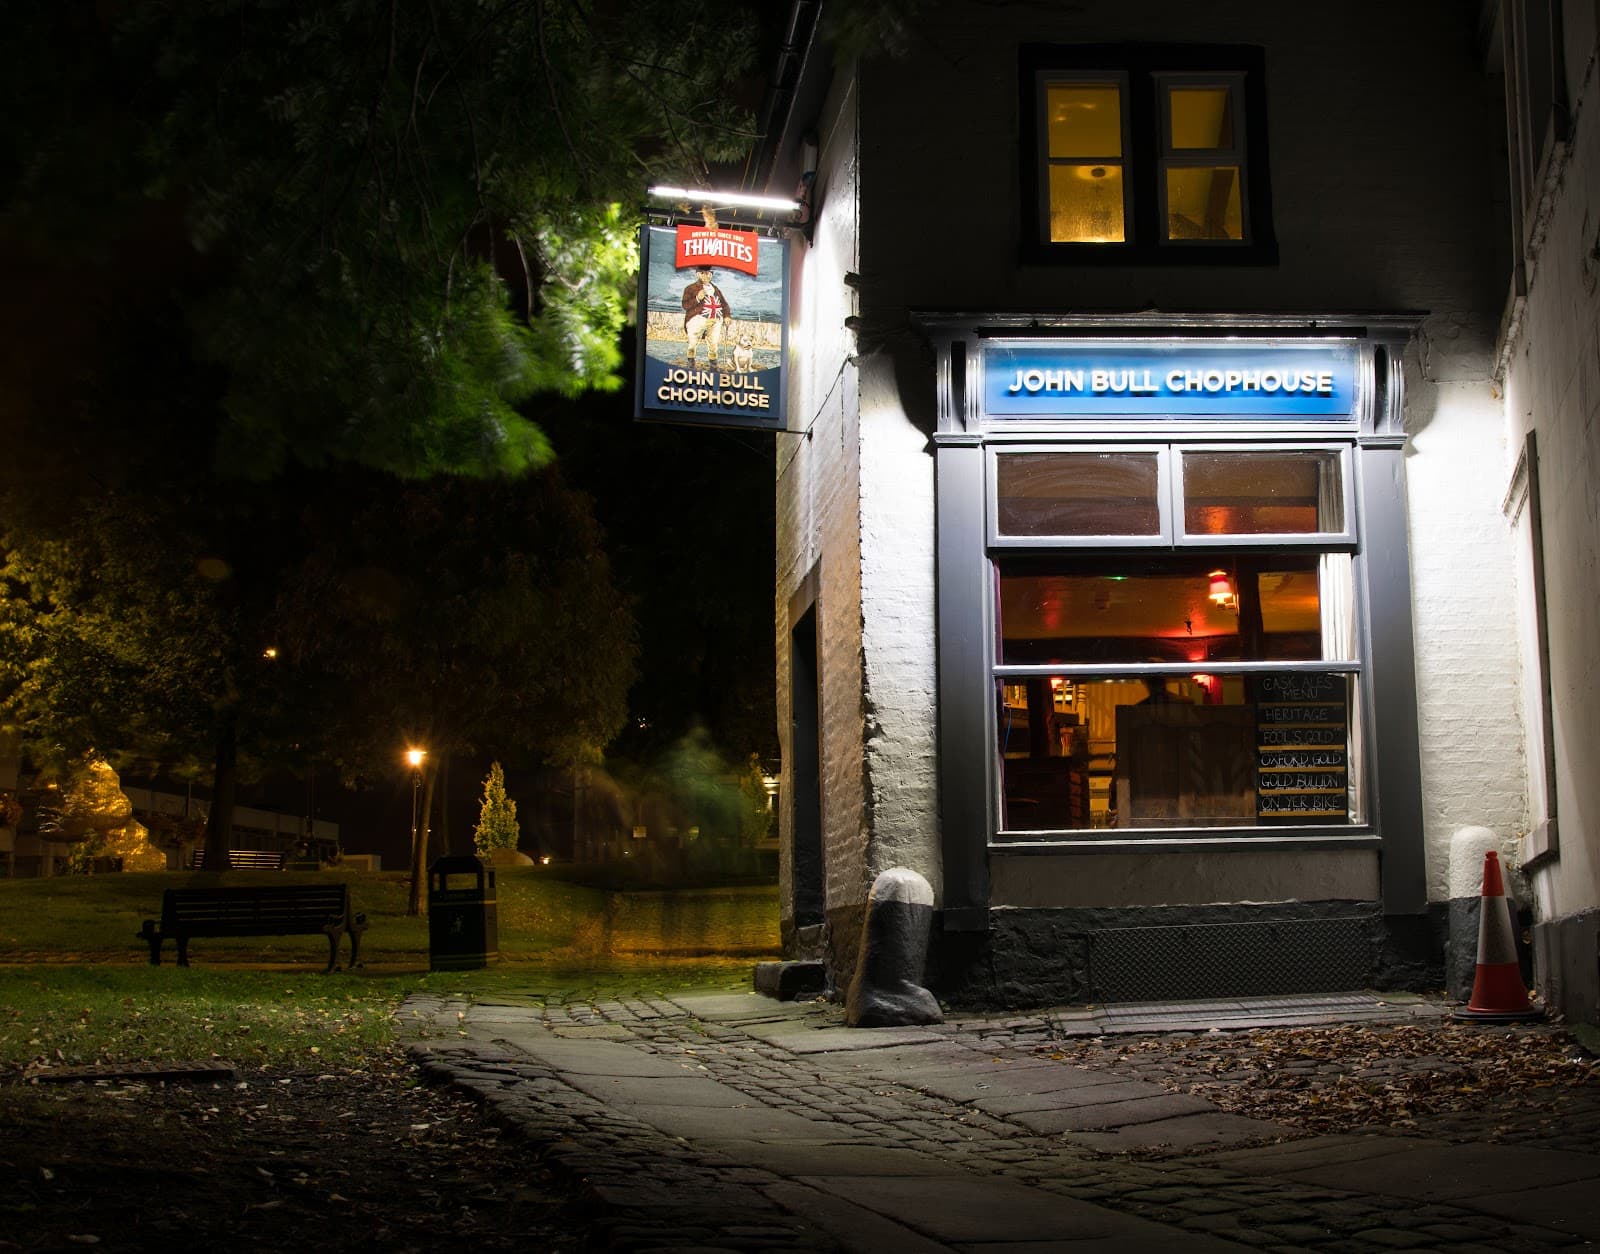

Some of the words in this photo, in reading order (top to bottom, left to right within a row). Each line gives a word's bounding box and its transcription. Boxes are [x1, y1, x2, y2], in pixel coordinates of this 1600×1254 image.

[683, 238, 753, 263] THWAITES
[663, 369, 714, 387] JOHN
[719, 373, 764, 391] BULL
[1008, 370, 1084, 392] JOHN
[1091, 370, 1159, 392] BULL
[1165, 370, 1334, 392] CHOPHOUSE
[657, 386, 770, 408] CHOPHOUSE
[1263, 676, 1295, 691] CASK
[1282, 687, 1318, 700] MENU
[1265, 708, 1328, 720] HERITAGE
[1261, 753, 1309, 766] OXFORD
[1312, 753, 1342, 765] GOLD
[1261, 773, 1293, 787] GOLD
[1296, 774, 1338, 787] BULLION
[1262, 797, 1280, 808] ON
[1313, 795, 1342, 808] BIKE
